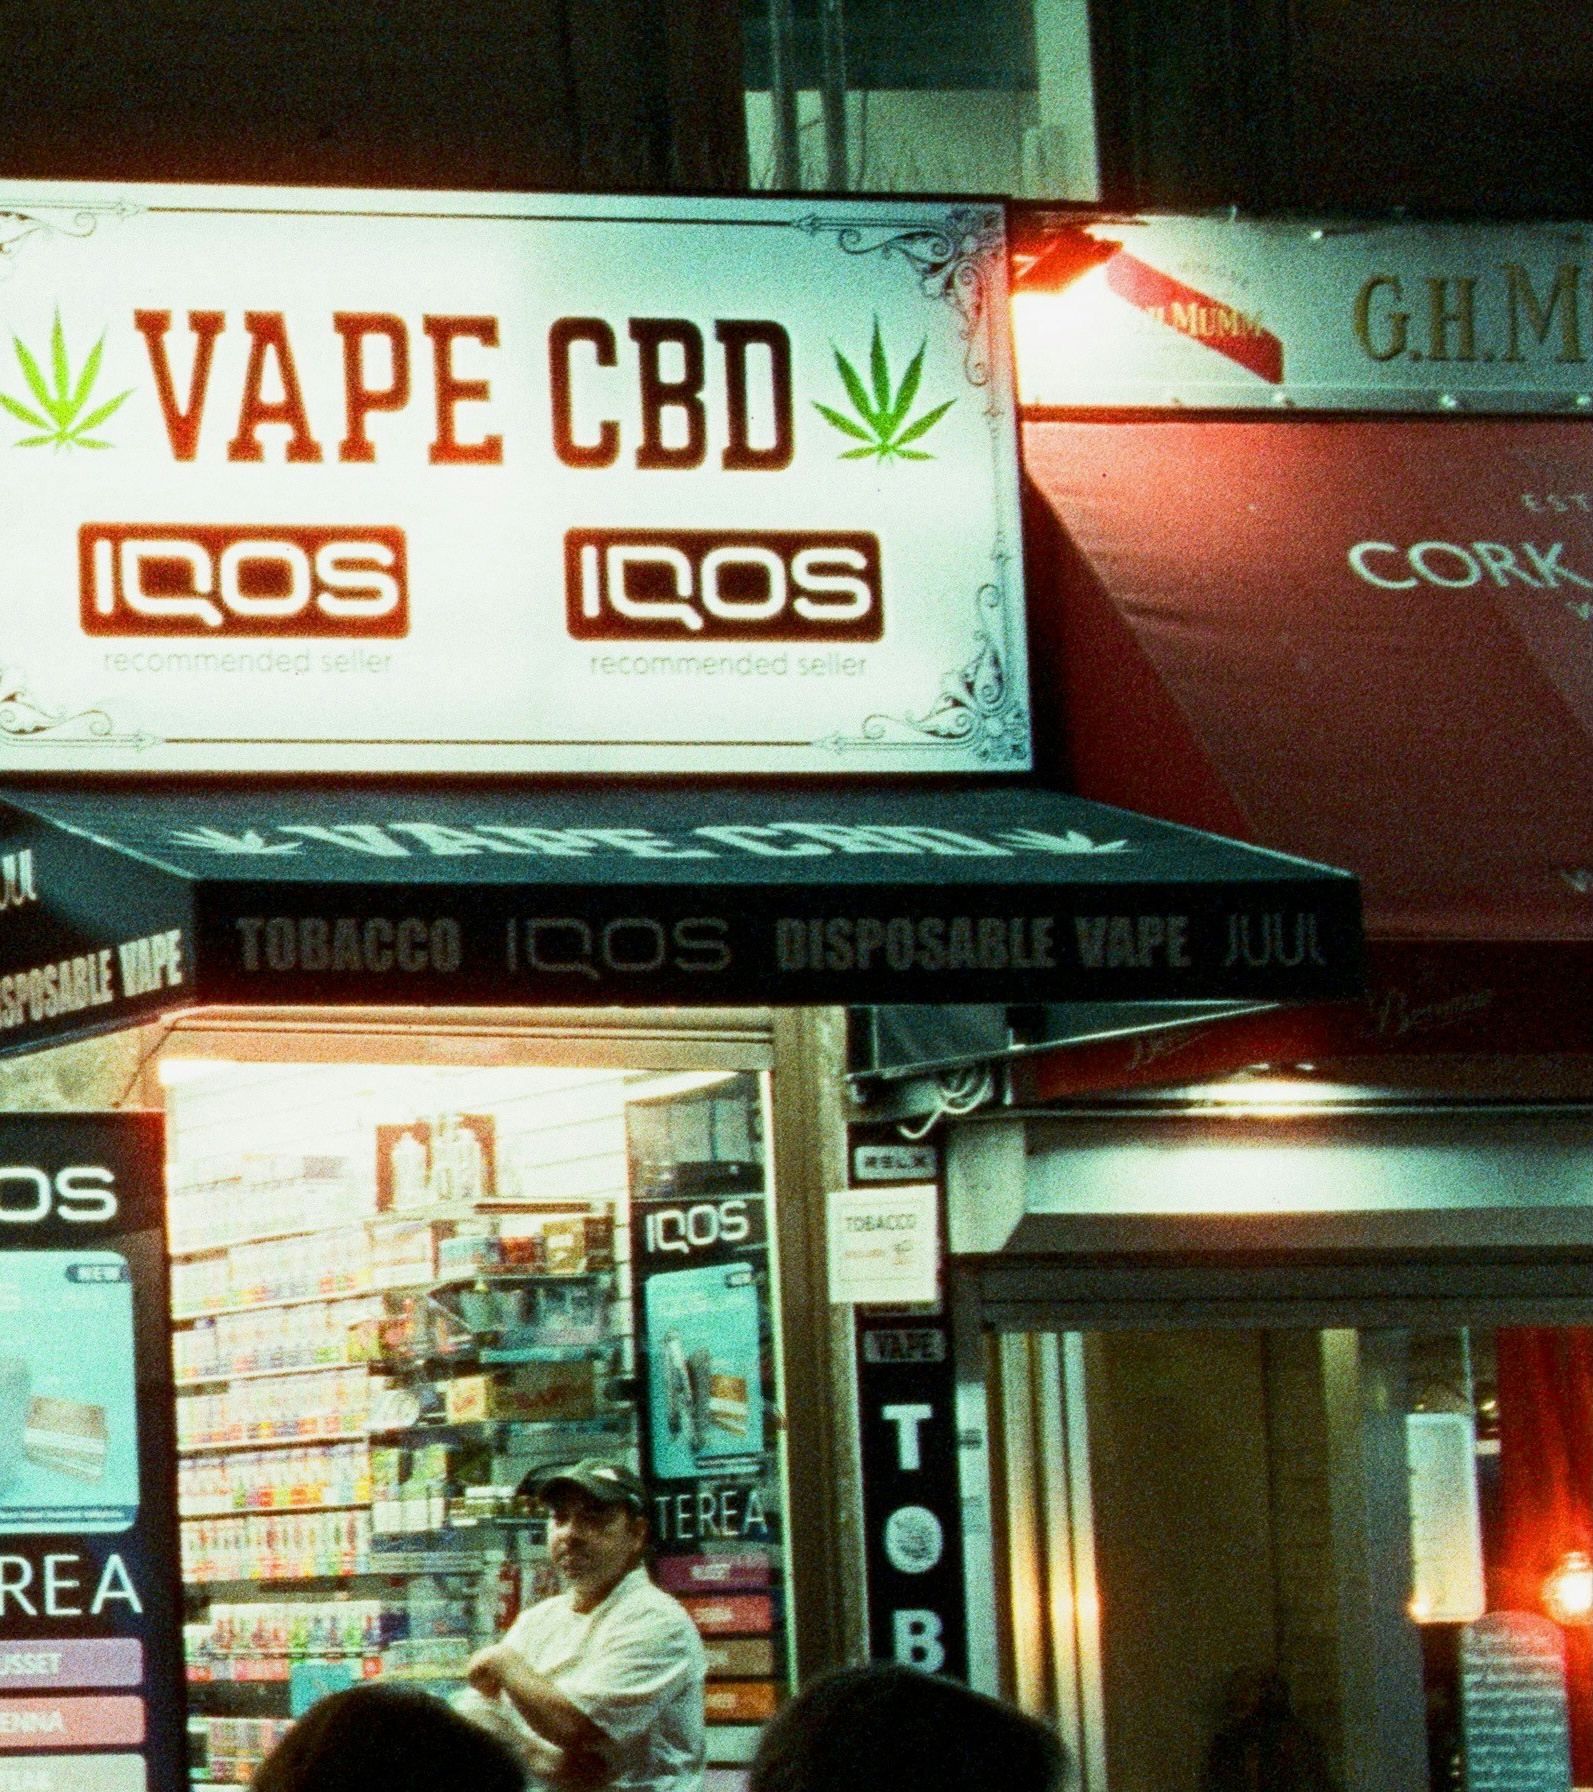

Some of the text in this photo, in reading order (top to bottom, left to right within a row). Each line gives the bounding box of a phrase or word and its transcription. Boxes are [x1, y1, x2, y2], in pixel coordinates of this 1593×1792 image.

[133, 308, 795, 472] VAPE CBD
[93, 537, 402, 628] IQOS
[580, 545, 873, 632] IQOS
[1348, 539, 1593, 592] CORK
[103, 648, 393, 676] recommended seller
[590, 652, 869, 679] recommended seller
[277, 821, 1017, 859] VAPE CBD
[119, 928, 183, 998] VAPE
[234, 916, 462, 973] TOBACCO
[506, 916, 733, 982] IQOS
[776, 915, 1057, 972] DISPOSABLE
[1072, 914, 1194, 970] VAPE
[646, 1201, 750, 1254] IQOS
[655, 1491, 768, 1542] TEREA
